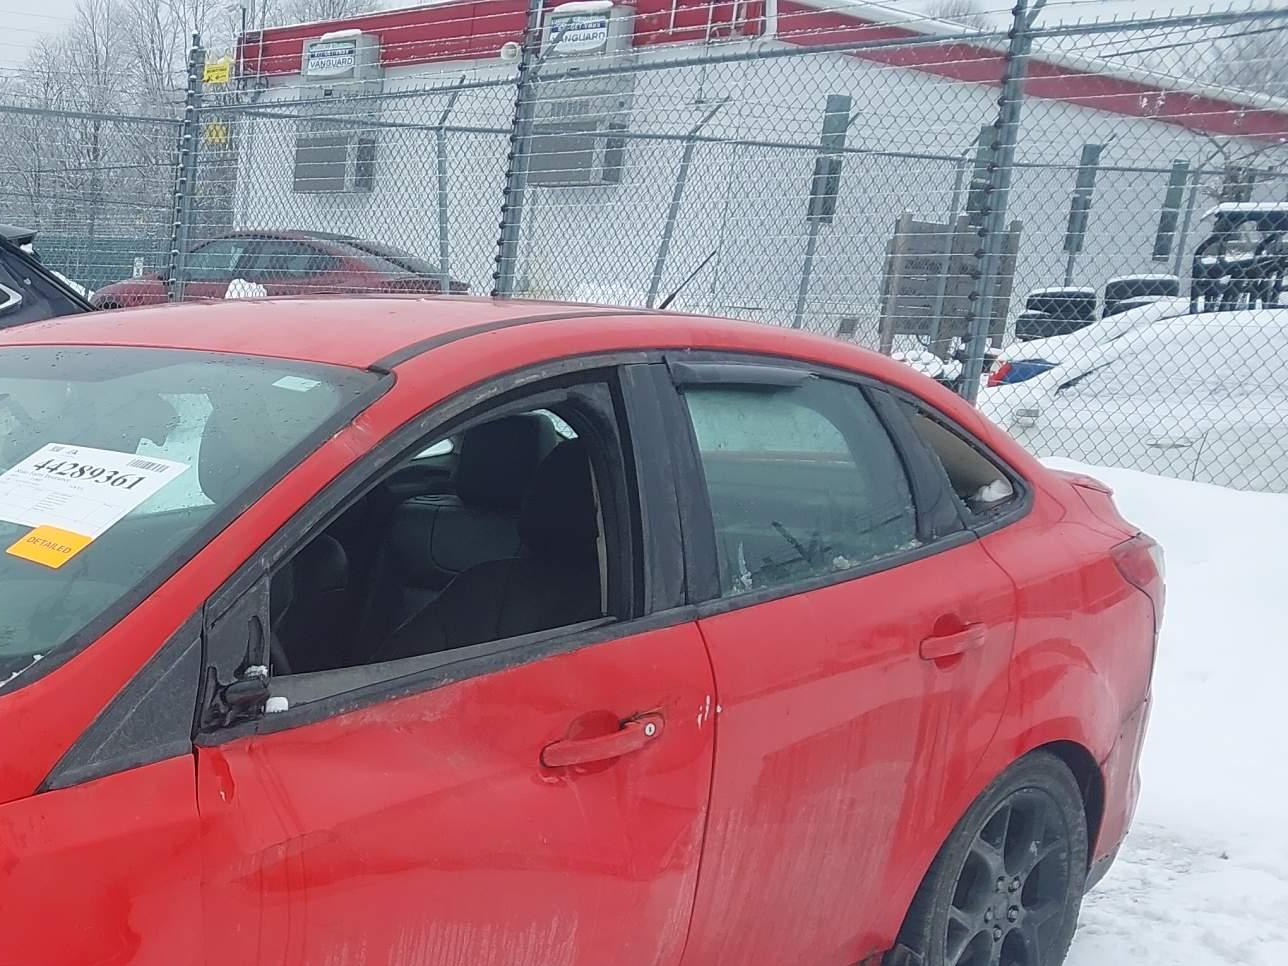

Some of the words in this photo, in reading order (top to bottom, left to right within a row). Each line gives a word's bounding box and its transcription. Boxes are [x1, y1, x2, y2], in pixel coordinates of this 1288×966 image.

[310, 57, 353, 69] VANGUARD
[33, 458, 147, 490] 44289361
[26, 536, 72, 554] DETAILED
